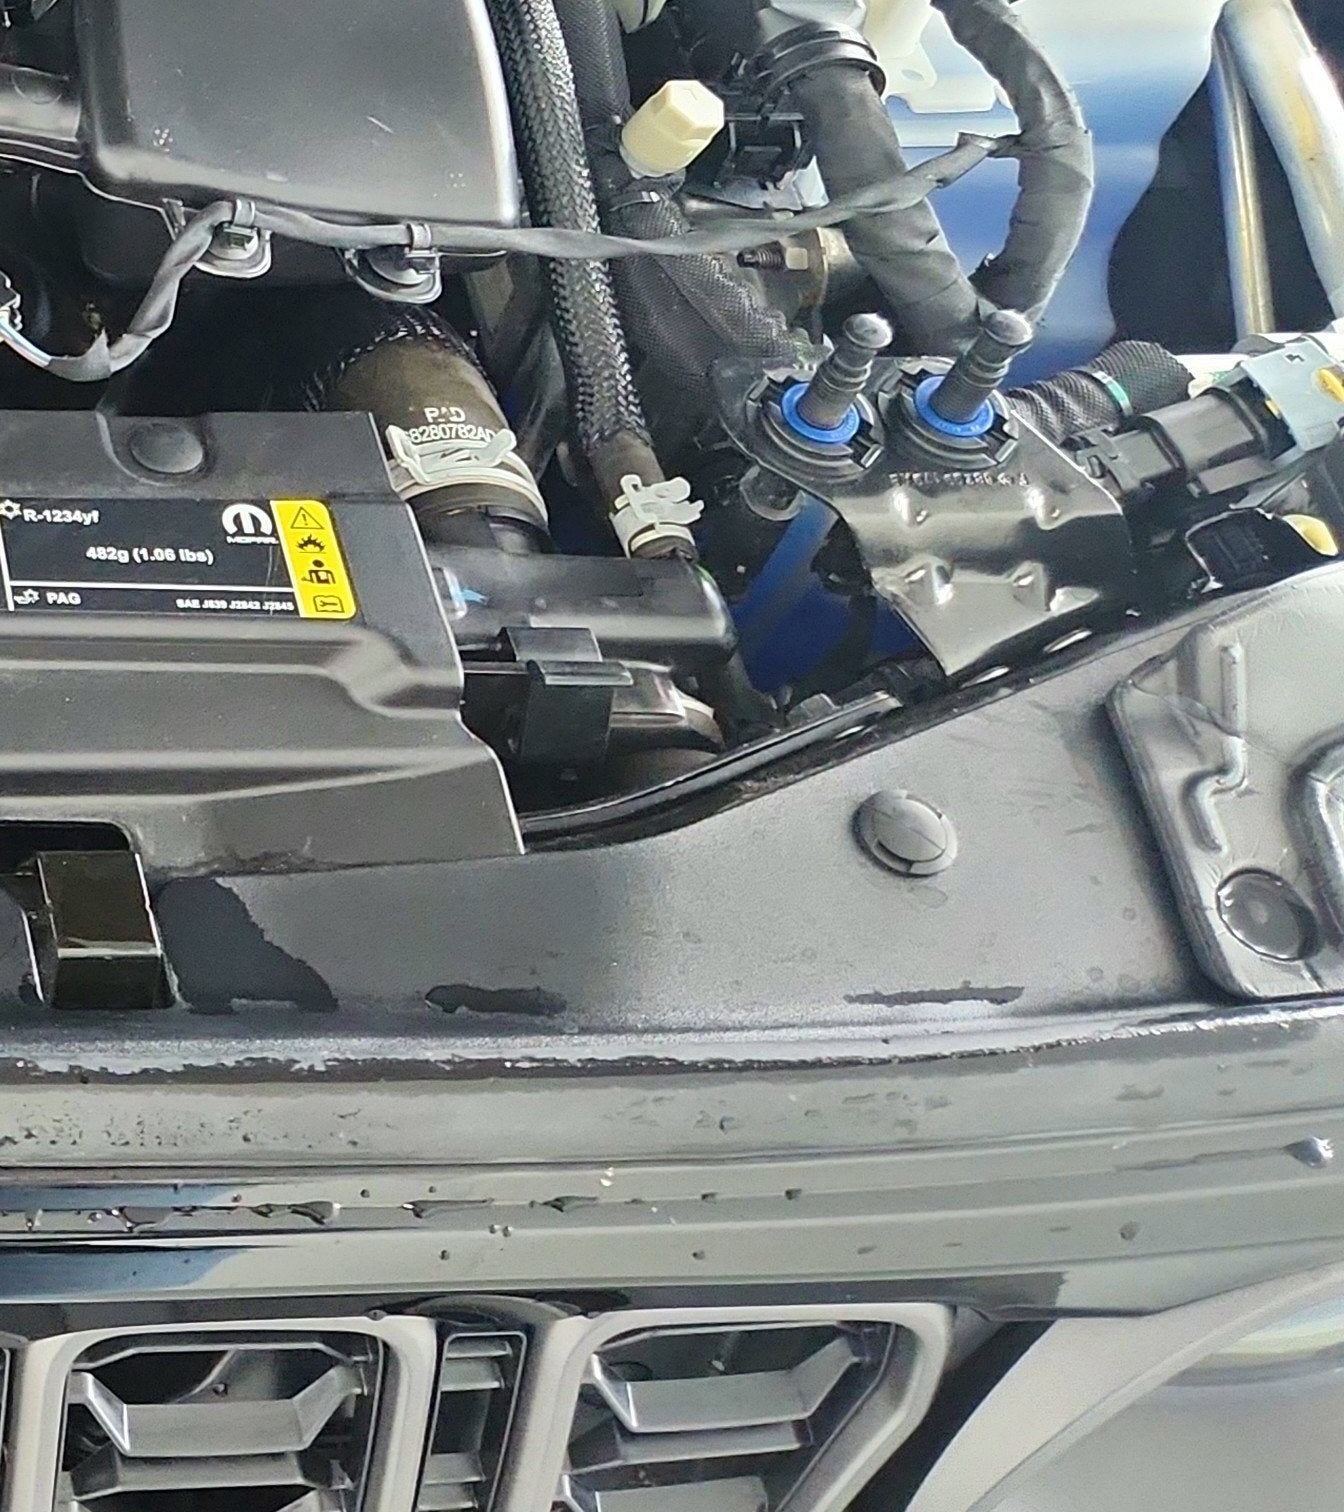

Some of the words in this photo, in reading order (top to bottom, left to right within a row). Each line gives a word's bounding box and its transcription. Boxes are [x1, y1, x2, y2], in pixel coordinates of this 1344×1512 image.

[23, 510, 99, 526] R-1234yf
[85, 547, 130, 563] 482g
[133, 547, 176, 564] (1.06
[180, 548, 214, 565] lbs)
[47, 592, 81, 605] PAG
[176, 598, 200, 609] SAE
